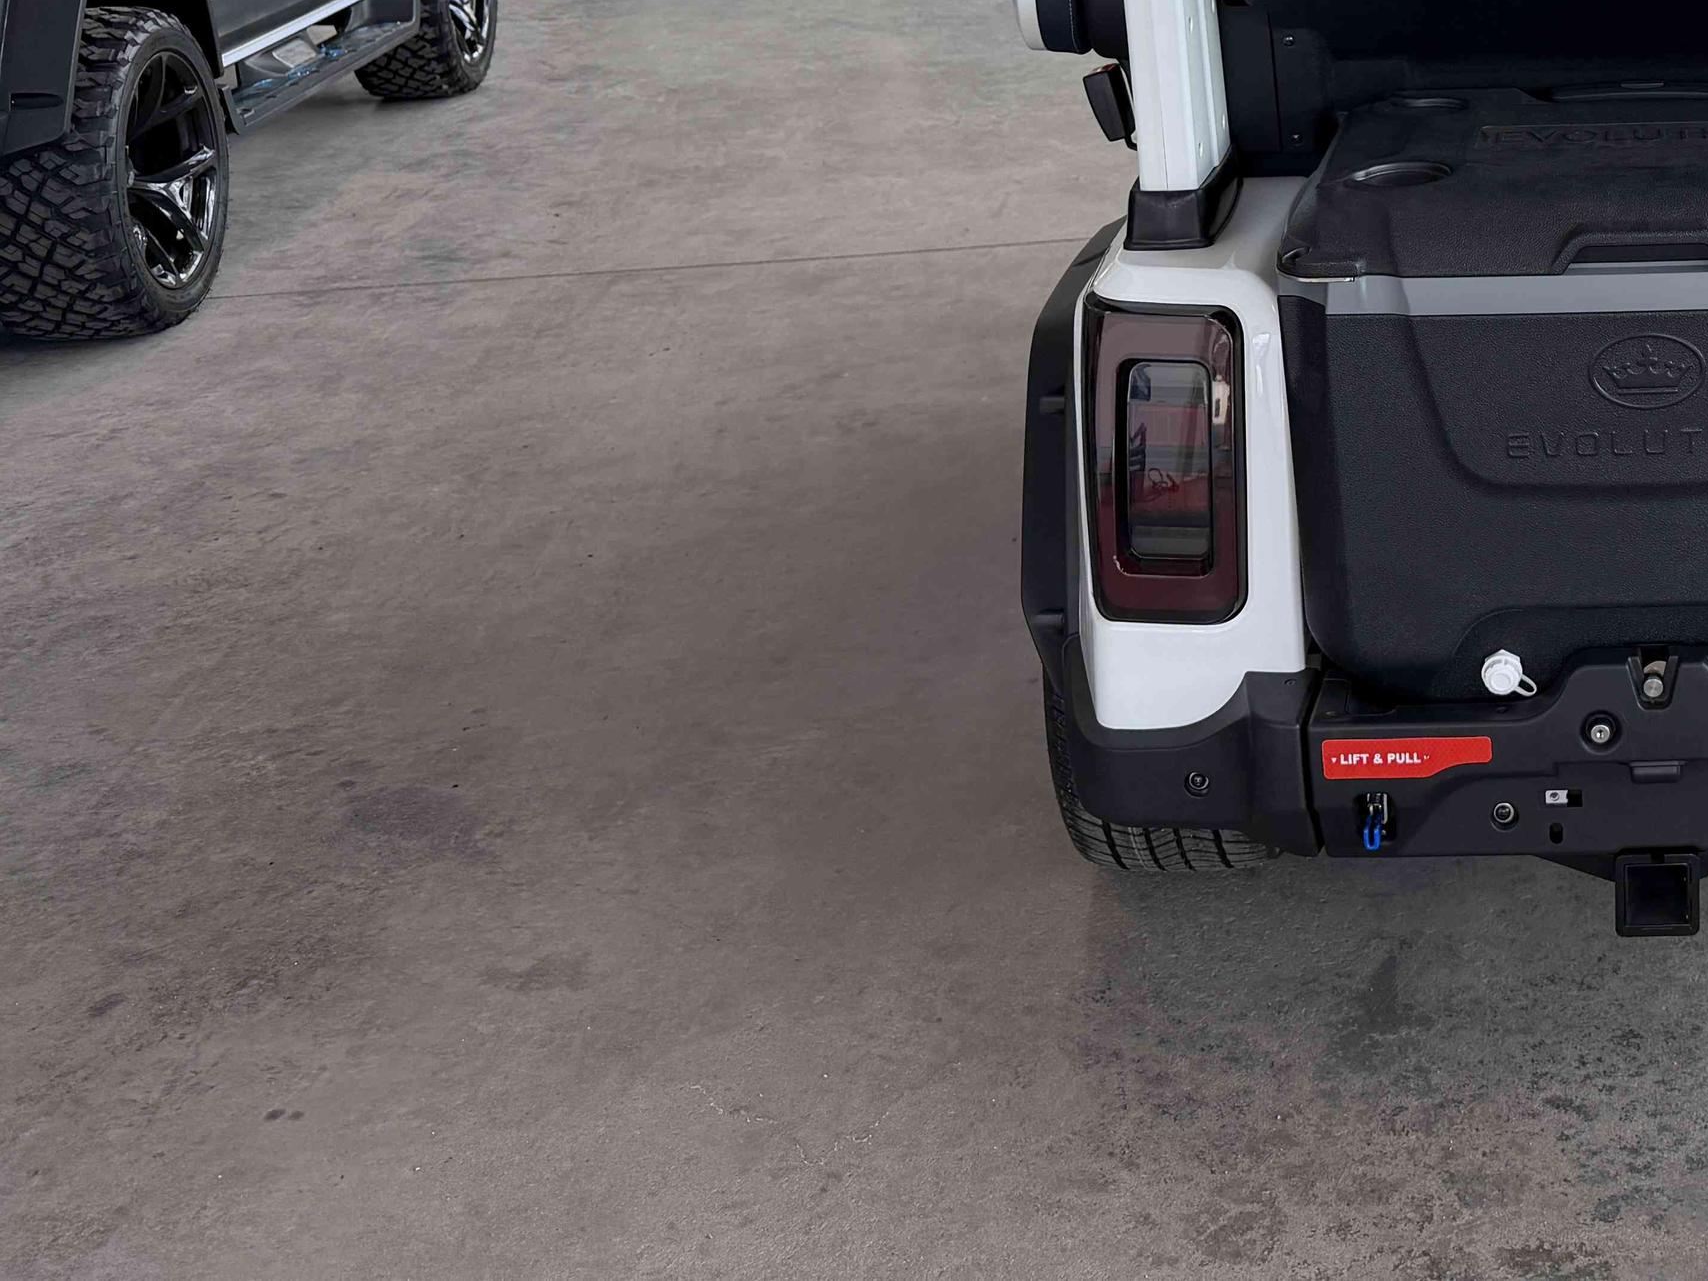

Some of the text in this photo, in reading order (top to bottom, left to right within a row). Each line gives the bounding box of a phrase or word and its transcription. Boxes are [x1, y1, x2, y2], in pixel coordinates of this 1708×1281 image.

[1340, 752, 1421, 765] LIFT & PULL
